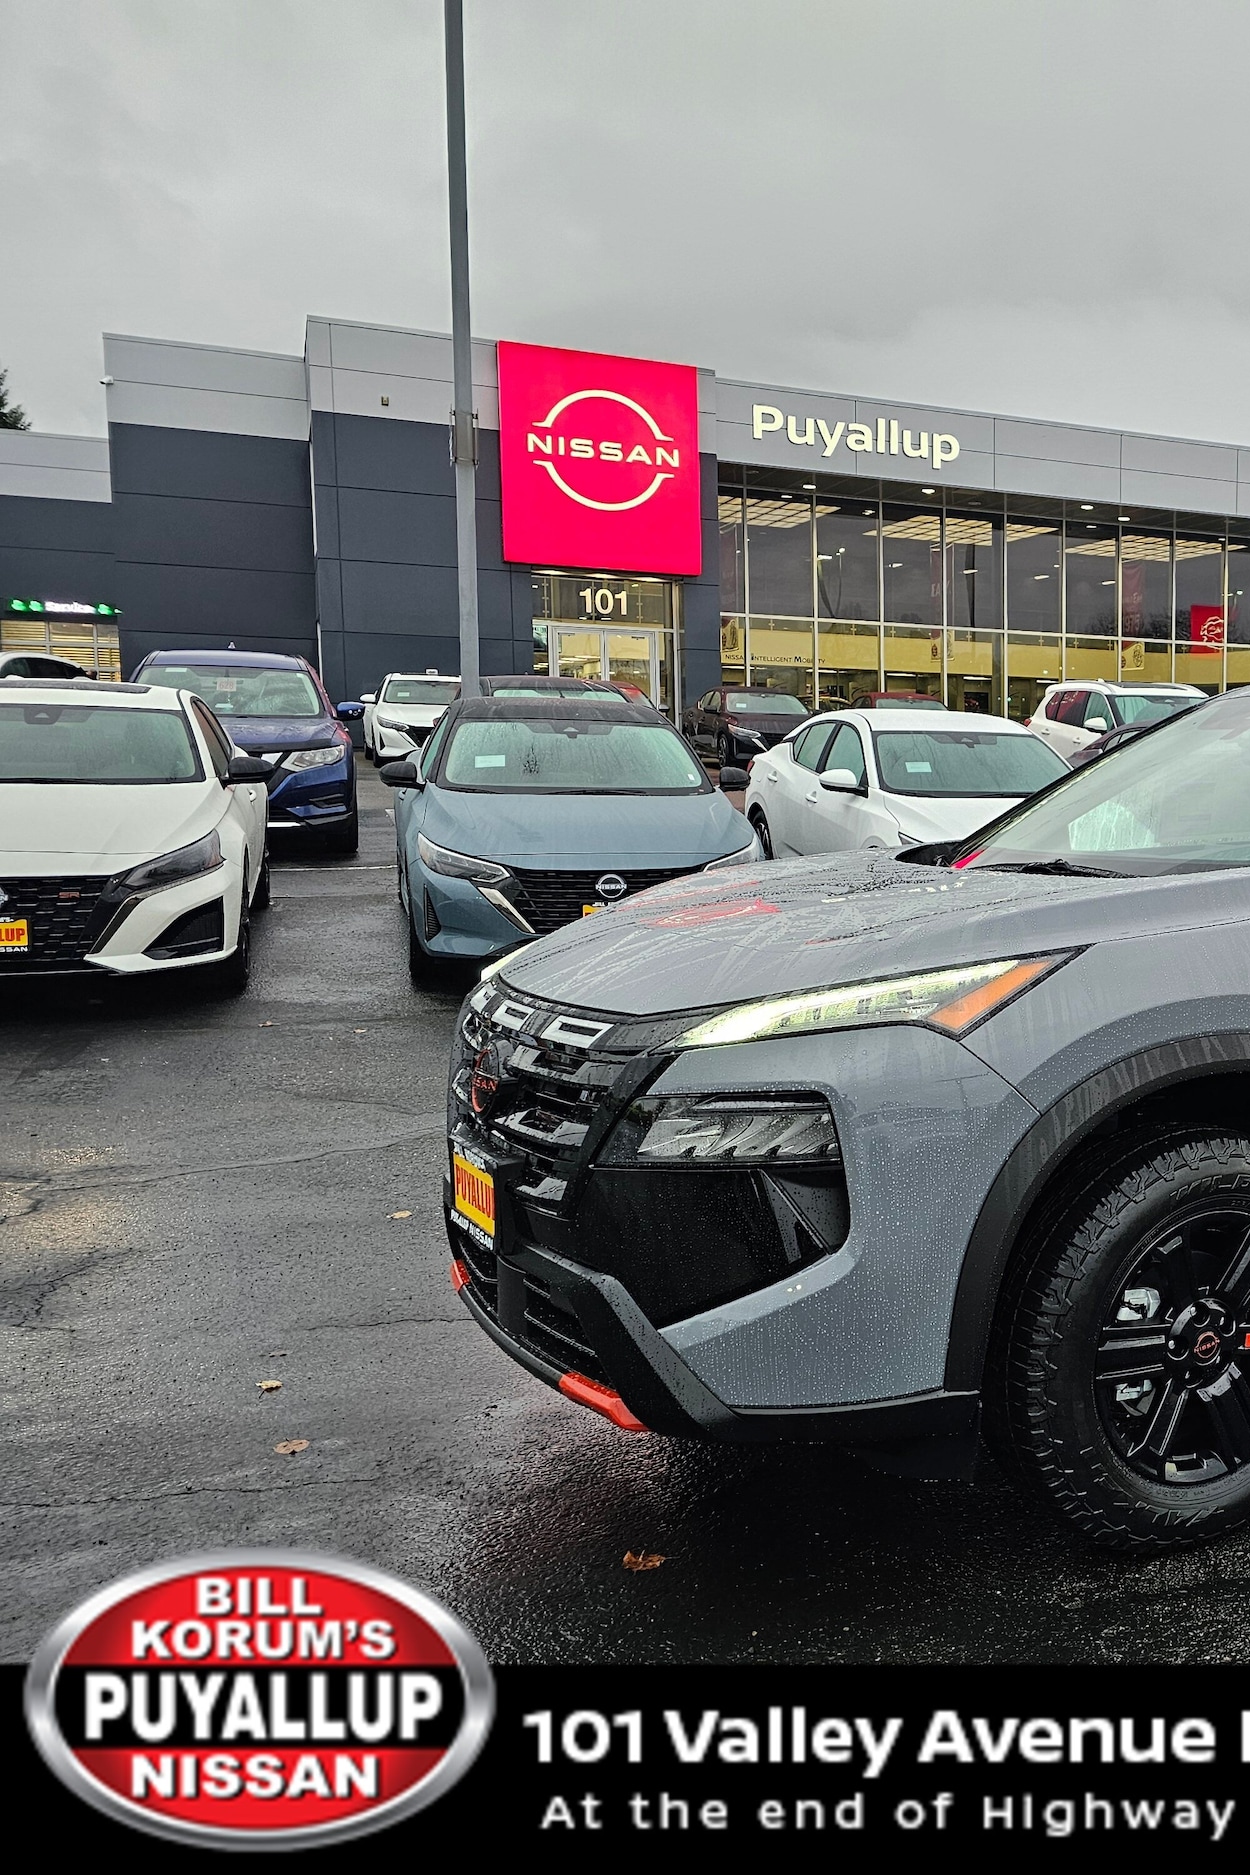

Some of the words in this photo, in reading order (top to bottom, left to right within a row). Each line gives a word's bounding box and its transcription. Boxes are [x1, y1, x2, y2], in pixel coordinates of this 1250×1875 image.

[527, 432, 680, 468] NISSAN
[752, 404, 960, 470] Puyallup
[579, 588, 627, 616] 101
